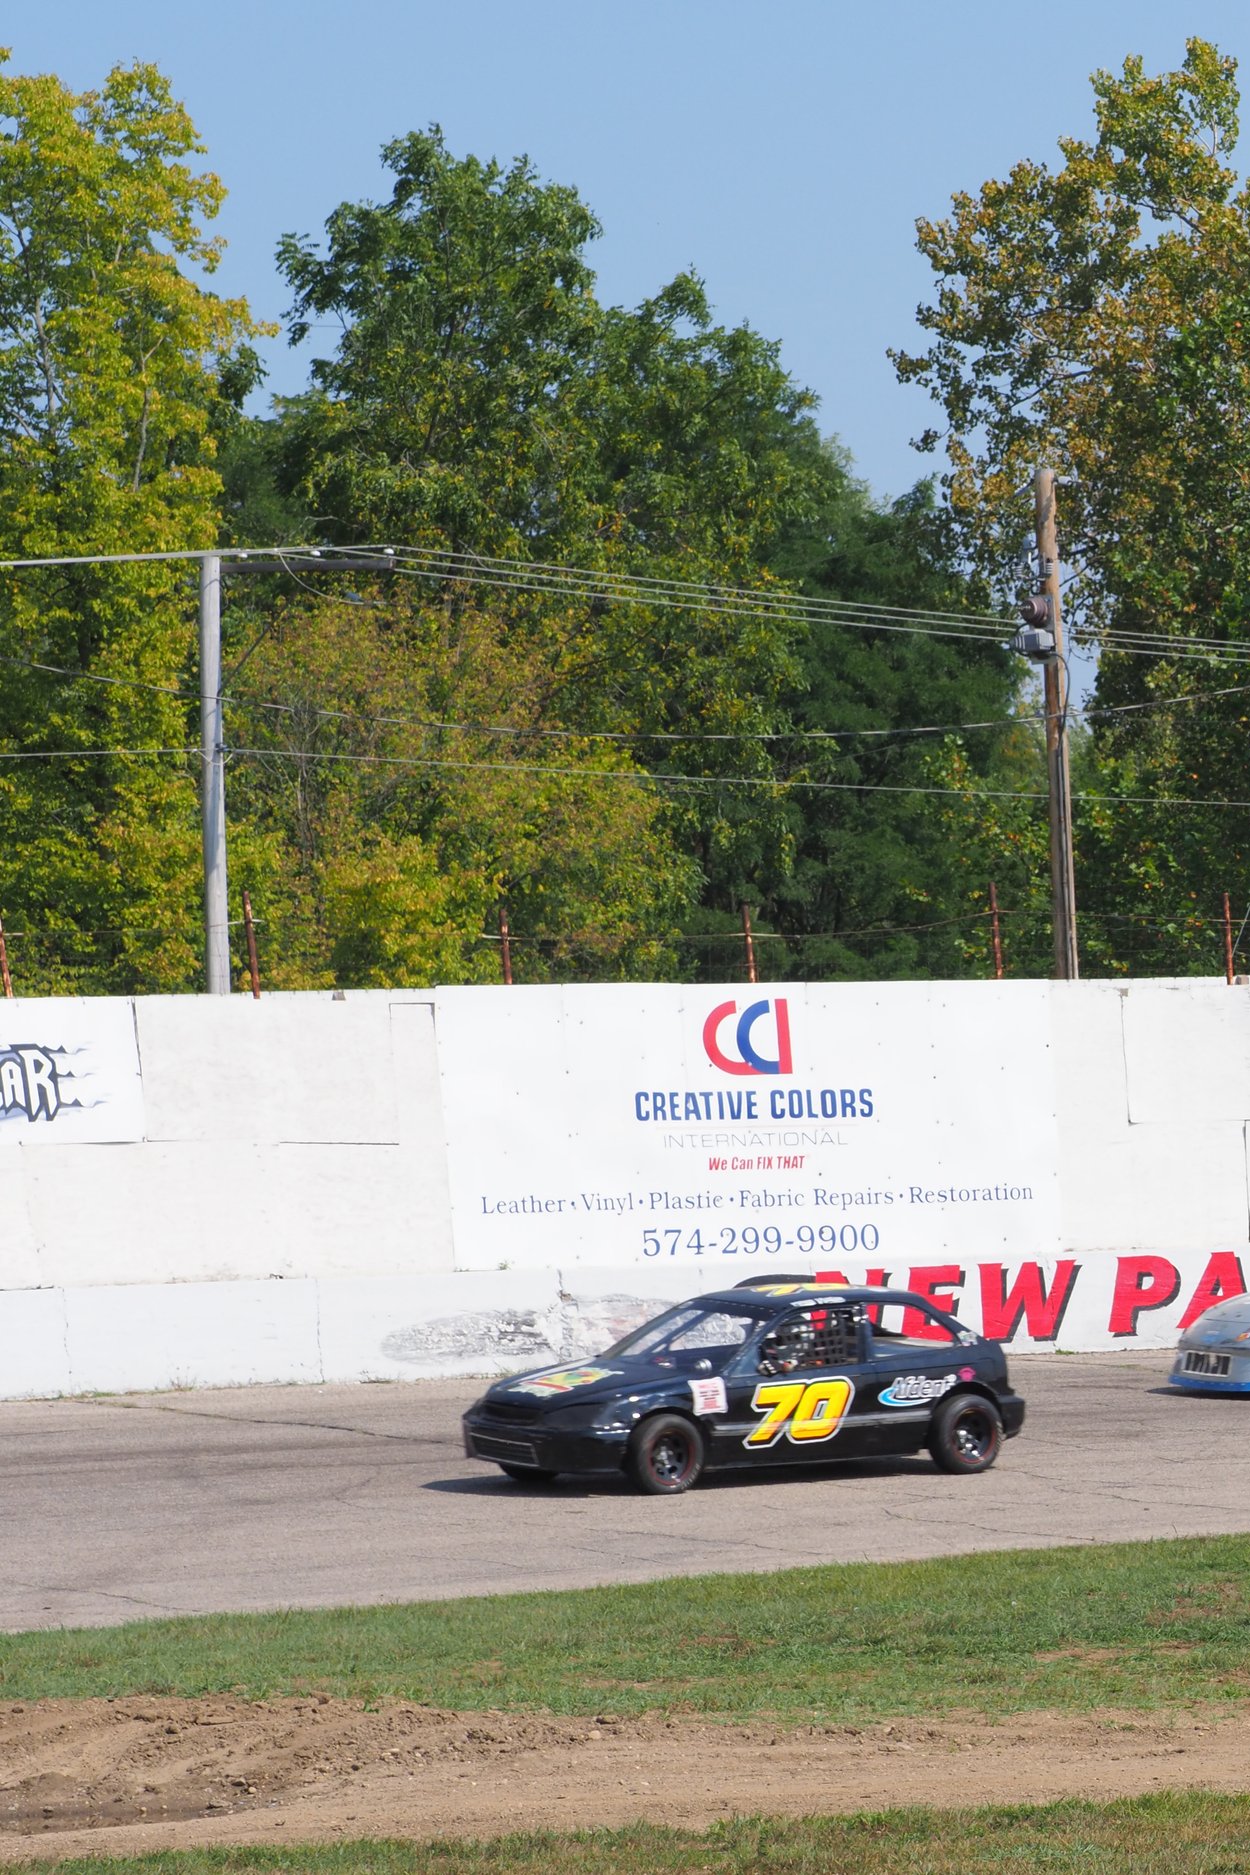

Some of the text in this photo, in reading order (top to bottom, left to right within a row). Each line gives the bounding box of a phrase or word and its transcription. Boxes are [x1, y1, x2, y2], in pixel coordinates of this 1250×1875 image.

[0, 1044, 61, 1122] AR
[635, 1087, 873, 1121] CREATIVE COLORS
[663, 1128, 848, 1149] INTERNATIONAL
[708, 1155, 805, 1170] We Can FIX THAT
[481, 1183, 1034, 1216] Leather Vinyl Plastic Fabric Repairs Restoration
[642, 1223, 880, 1257] 574-299-9900
[743, 1376, 855, 1449] 70
